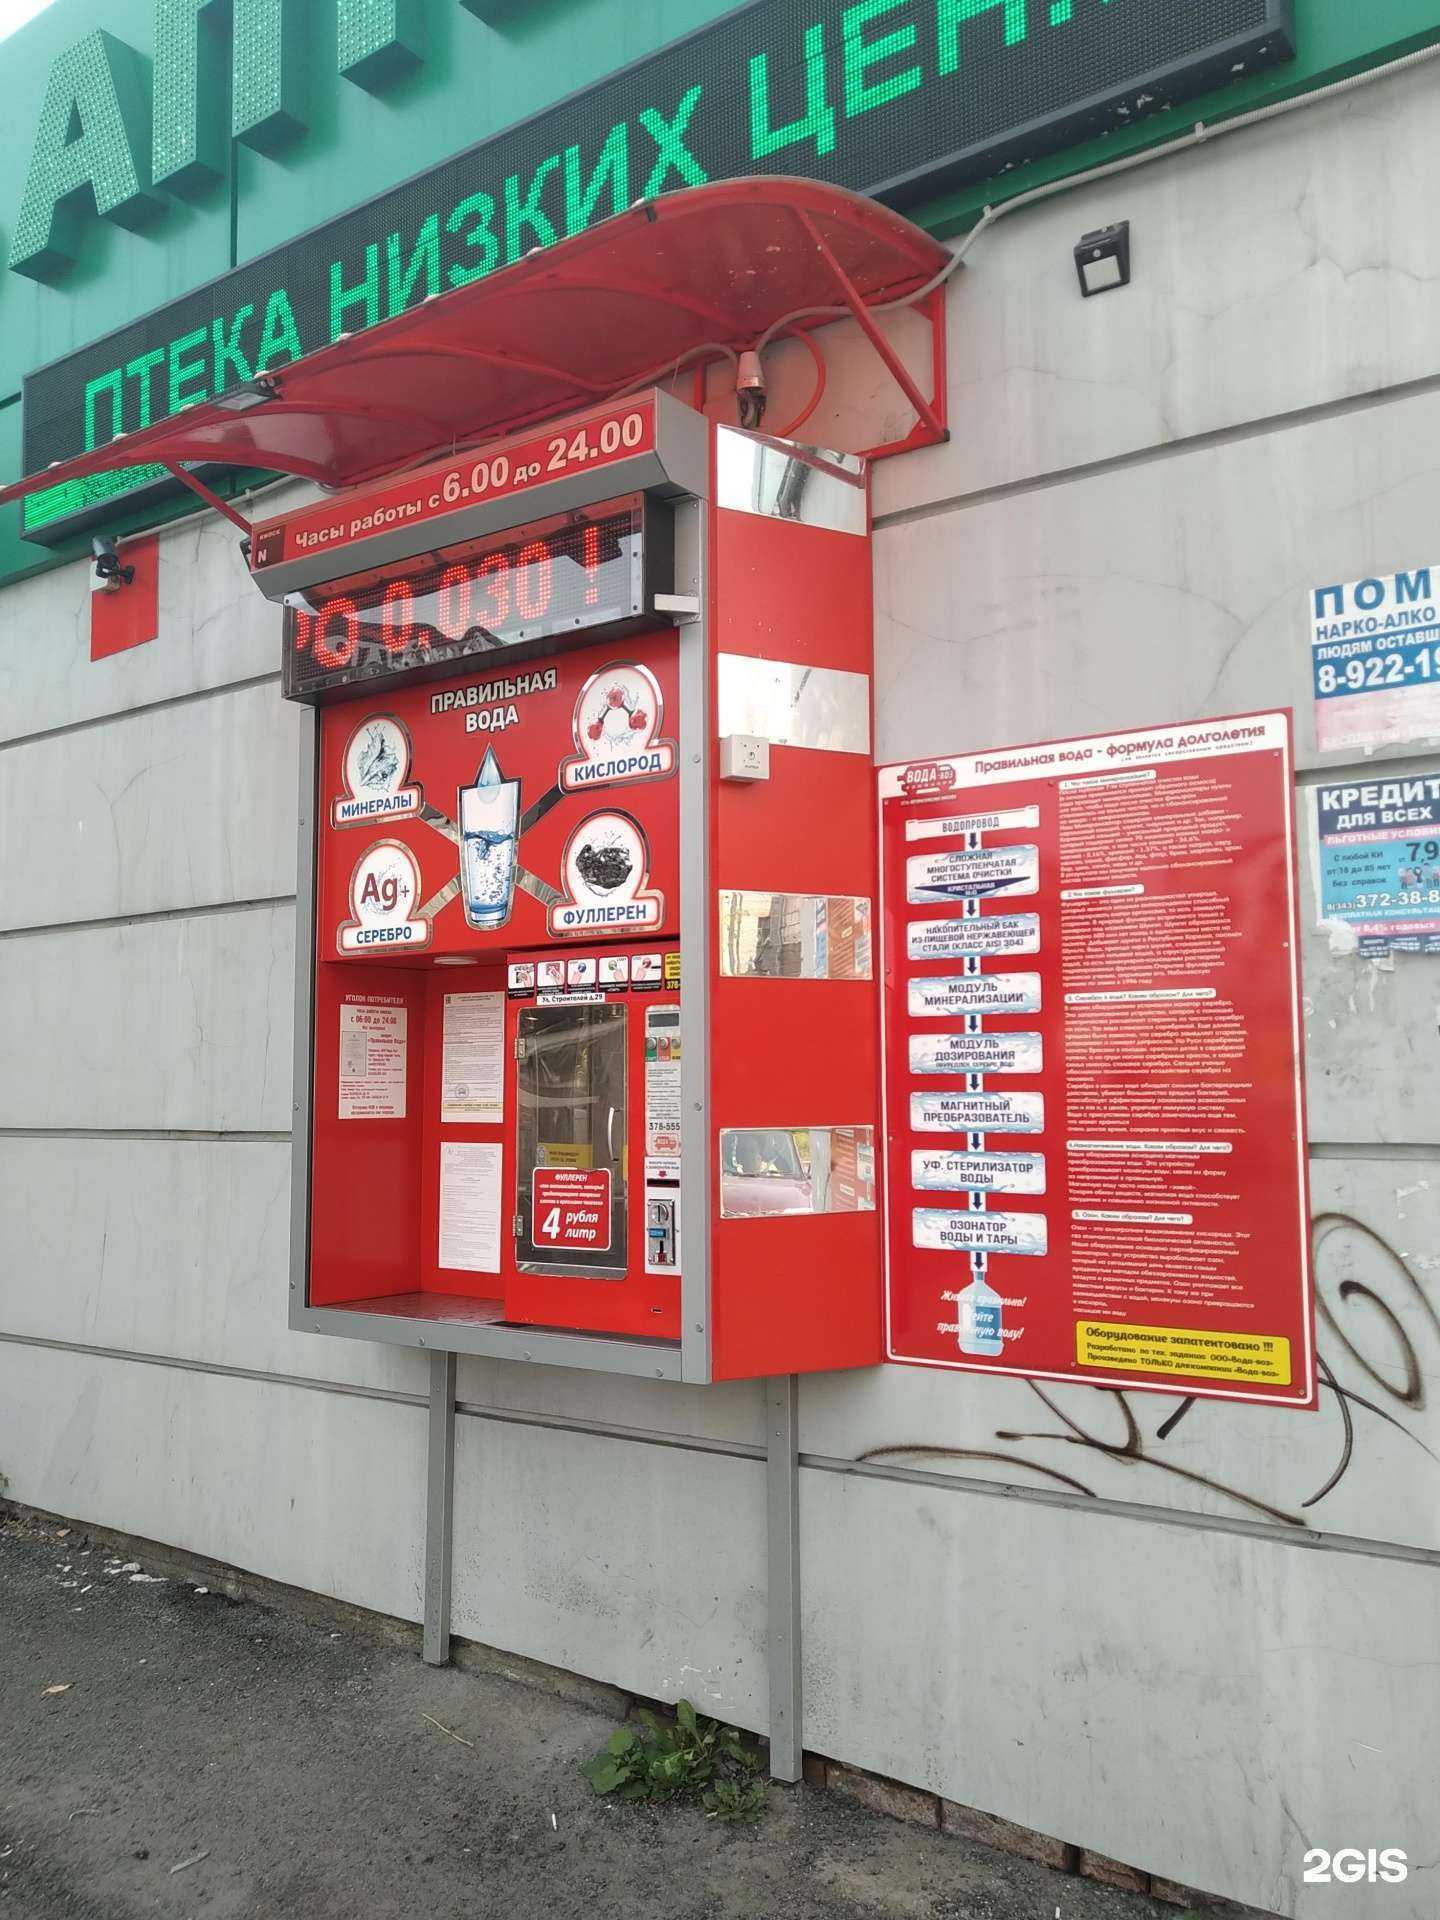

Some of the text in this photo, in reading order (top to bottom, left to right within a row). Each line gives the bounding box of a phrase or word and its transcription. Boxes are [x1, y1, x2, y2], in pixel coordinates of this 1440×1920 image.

[329, 85, 707, 342] НИЗКИХ
[295, 413, 643, 548] Часы работы с 6.00 до 24.00
[1316, 606, 1437, 640] НАРКО-АЛКО
[1317, 640, 1373, 660] ЛЮДЯМ
[431, 668, 557, 714] ПРАВИЛЬНАЯ
[465, 705, 519, 734] ВОДА
[975, 754, 1054, 774] Правильная
[1059, 747, 1093, 762] вода
[1106, 737, 1174, 758] формула
[1178, 726, 1266, 746] долголетия
[574, 753, 662, 782] КИСЛОРОД
[1322, 779, 1440, 811] КРЕДИТ
[341, 794, 412, 818] МИНЕРАЛЫ
[942, 817, 1000, 833] ВОДОПРОВОД
[1336, 806, 1433, 830] ДЛЯ ВСЕХ
[1326, 832, 1388, 845] ЛЬГОТНЫЕ
[949, 852, 993, 863] СЛОЖНАЯ
[1342, 852, 1369, 861] любой
[1371, 851, 1383, 859] КИ
[926, 859, 1017, 874] МНОГОСТУПЕНЧАТАЯ
[931, 868, 1012, 882] СИСТЕМА ОЧИСТКИ
[1352, 877, 1387, 887] справок
[360, 872, 411, 911] Ag+
[563, 905, 647, 925] ФУЛЛЕРЕН
[356, 926, 412, 944] СЕРЕБРО
[926, 921, 1019, 935] НАКОПИТЕЛЬНЫЙ БАК
[912, 928, 1036, 944] ИЗ ПИЩЕВОЙ НЕРЖАВЕЮЩЕЙ
[922, 943, 950, 952] СТАЛИ
[949, 982, 998, 993] МОДУЛЬ
[924, 993, 1024, 1006] МИНЕРАЛИЗАЦИИ
[950, 1039, 1000, 1050] МОДУЛЬ
[934, 1051, 1016, 1061] ДОЗИРОВАНИЯ
[940, 1100, 1010, 1111] МАГНИТНЫЙ
[923, 1112, 1030, 1123] ПРЕОБРАЗОВАТЕЛЬ
[923, 1161, 1034, 1173] УФ. СТЕРИЛИЗАТОР
[960, 1173, 994, 1183] ВОДЫ
[542, 1207, 599, 1240] 4 рубля
[950, 1220, 1007, 1232] ОЗОНАТОР
[564, 1228, 597, 1241] литр
[940, 1231, 1018, 1245] ВОДЫ И ТАРЫ
[997, 1327, 1025, 1341] воду!
[1086, 1327, 1168, 1344] Оборудование
[1170, 1335, 1261, 1351] запатентовано
[1086, 1342, 1136, 1354] Разработано
[1169, 1350, 1206, 1360] заданию
[1087, 1352, 1138, 1365] Произведено
[1140, 1357, 1173, 1368] ТОЛЬКО
